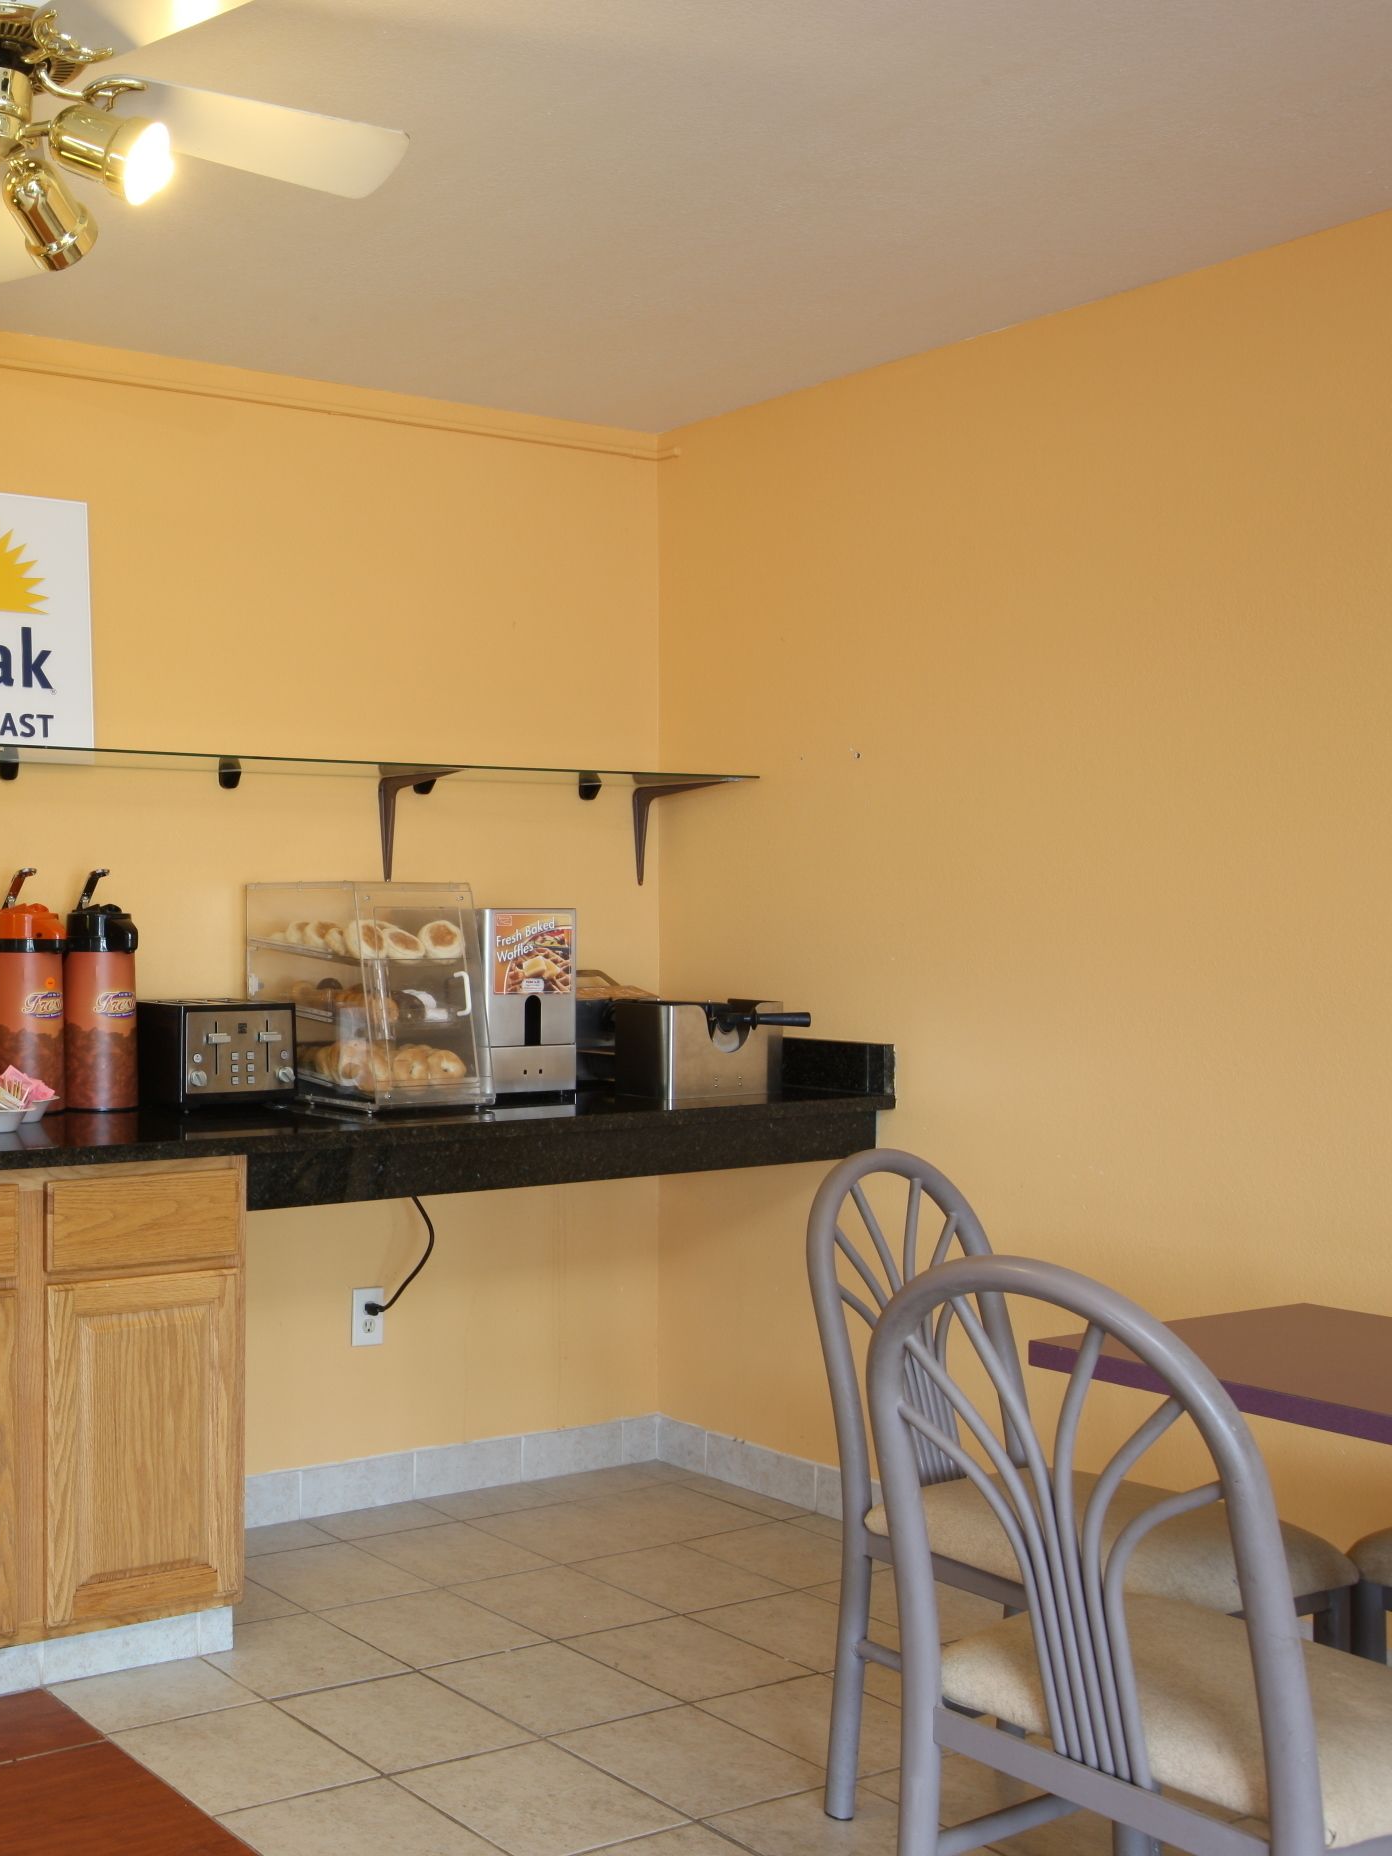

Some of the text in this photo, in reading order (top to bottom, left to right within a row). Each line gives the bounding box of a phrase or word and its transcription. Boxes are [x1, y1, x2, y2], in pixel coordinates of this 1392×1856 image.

[496, 929, 522, 947] Fresh
[525, 916, 555, 937] Baked
[496, 943, 534, 963] Waffles
